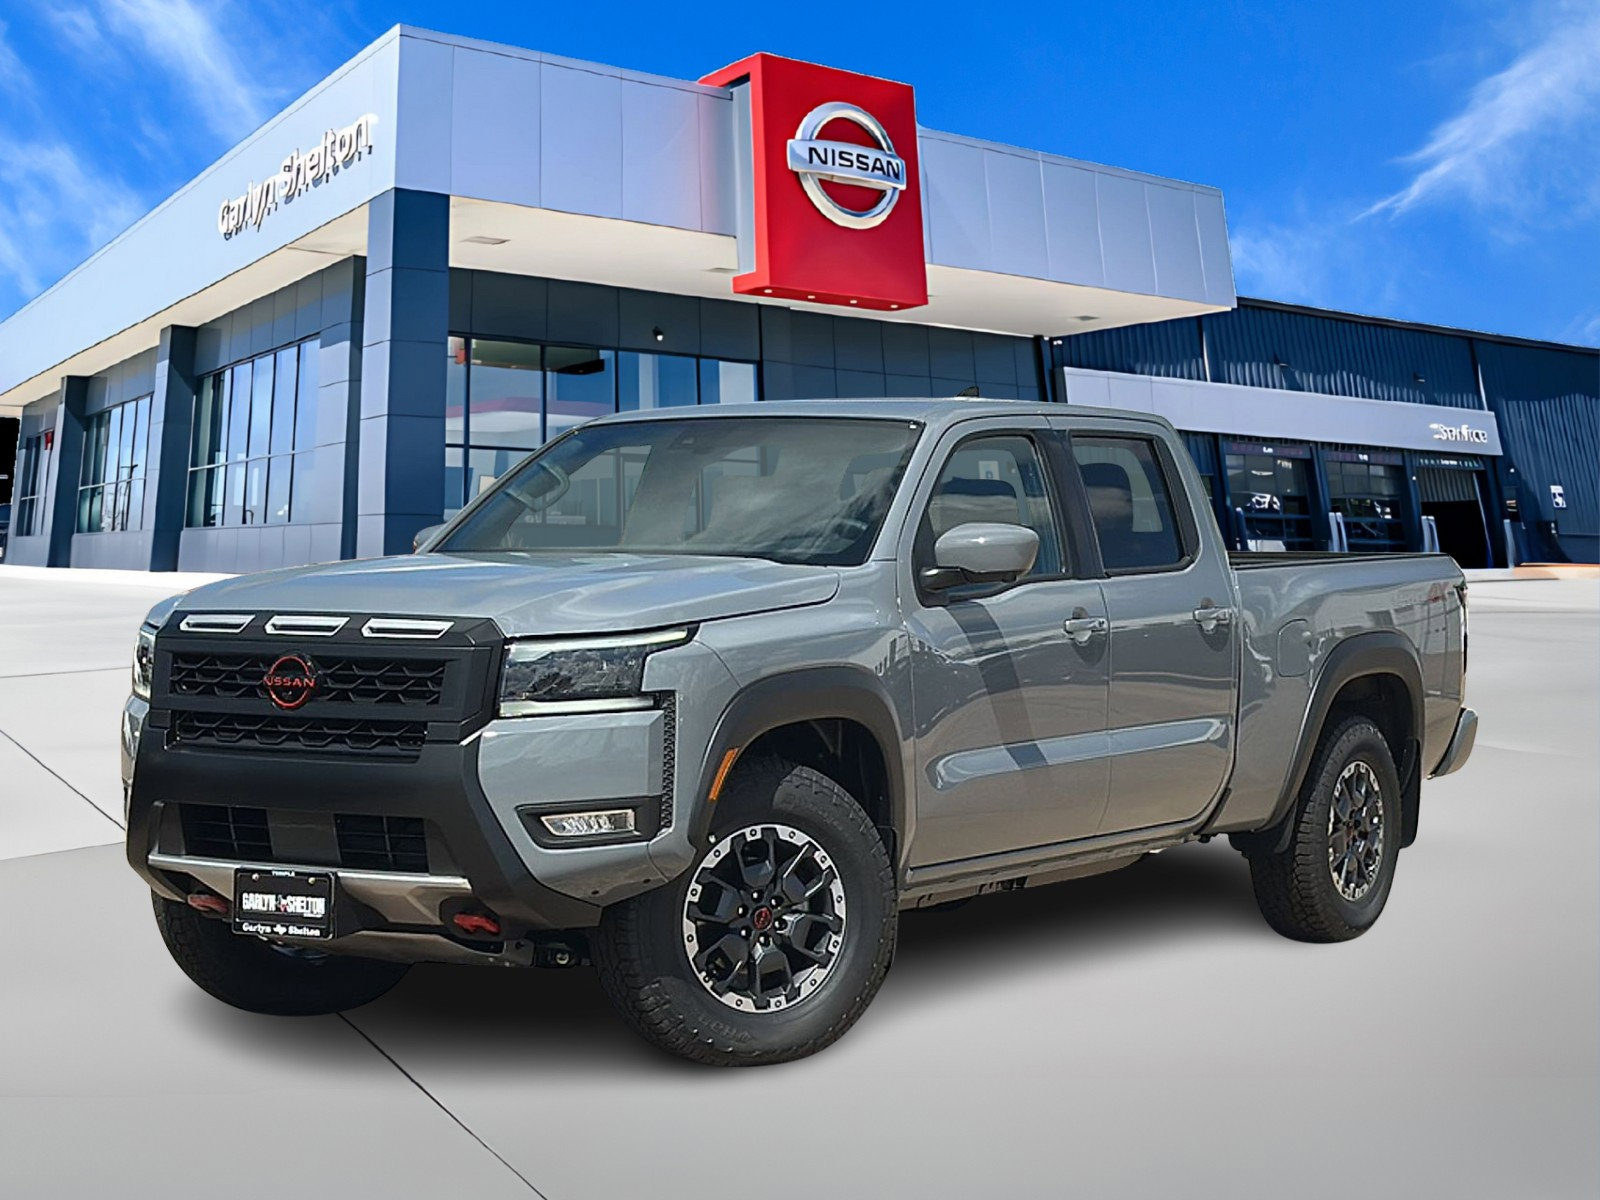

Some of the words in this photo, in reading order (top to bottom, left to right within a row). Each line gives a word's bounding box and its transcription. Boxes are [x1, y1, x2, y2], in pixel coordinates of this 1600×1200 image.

[279, 115, 377, 200] Shelton
[808, 146, 900, 180] NISSAN
[1429, 423, 1488, 443] Service
[263, 676, 316, 688] NISSAN
[286, 896, 325, 914] SHELTON
